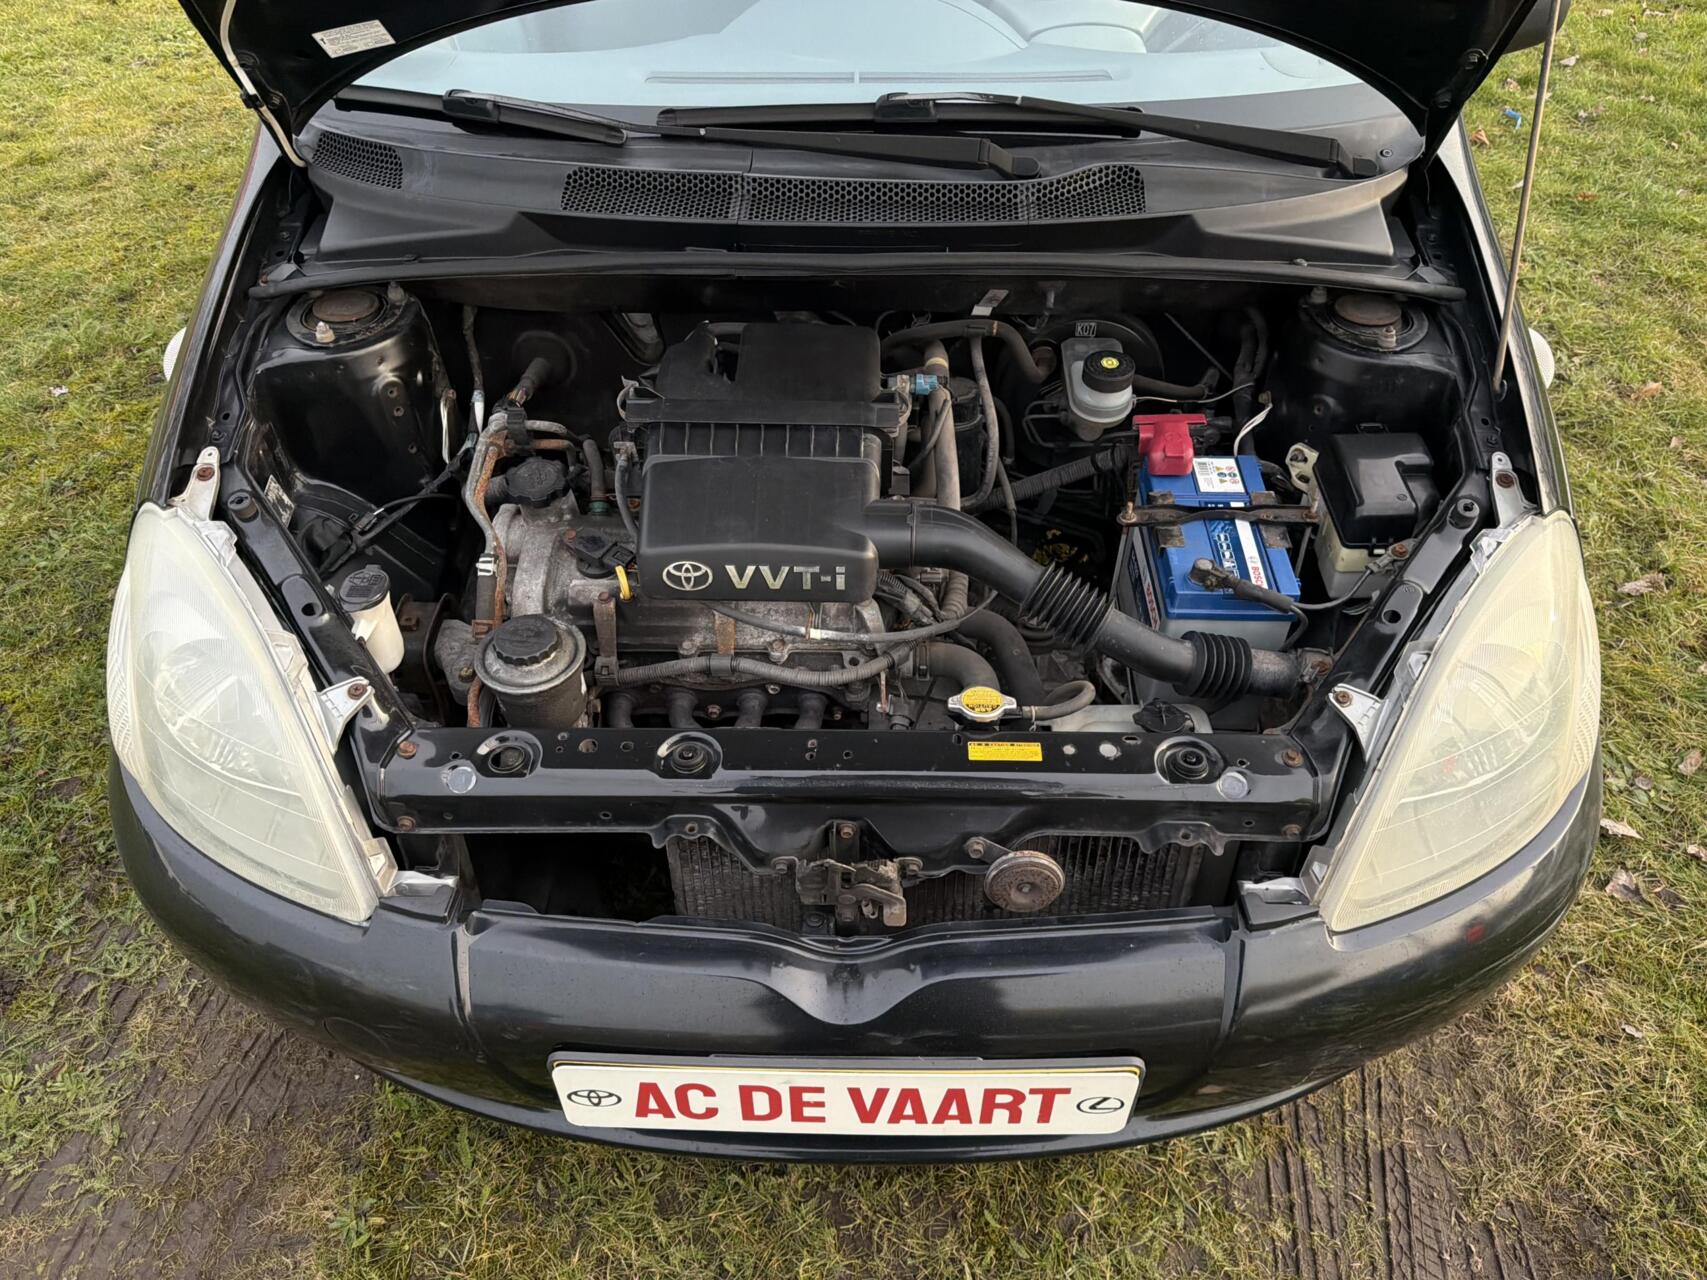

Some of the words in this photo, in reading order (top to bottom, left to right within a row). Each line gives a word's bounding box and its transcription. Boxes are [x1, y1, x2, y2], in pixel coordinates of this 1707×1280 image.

[1076, 323, 1096, 336] K07
[725, 564, 846, 590] VVT-i
[635, 1083, 718, 1120] AC
[739, 1085, 825, 1123] DE
[848, 1088, 1071, 1124] VAART
